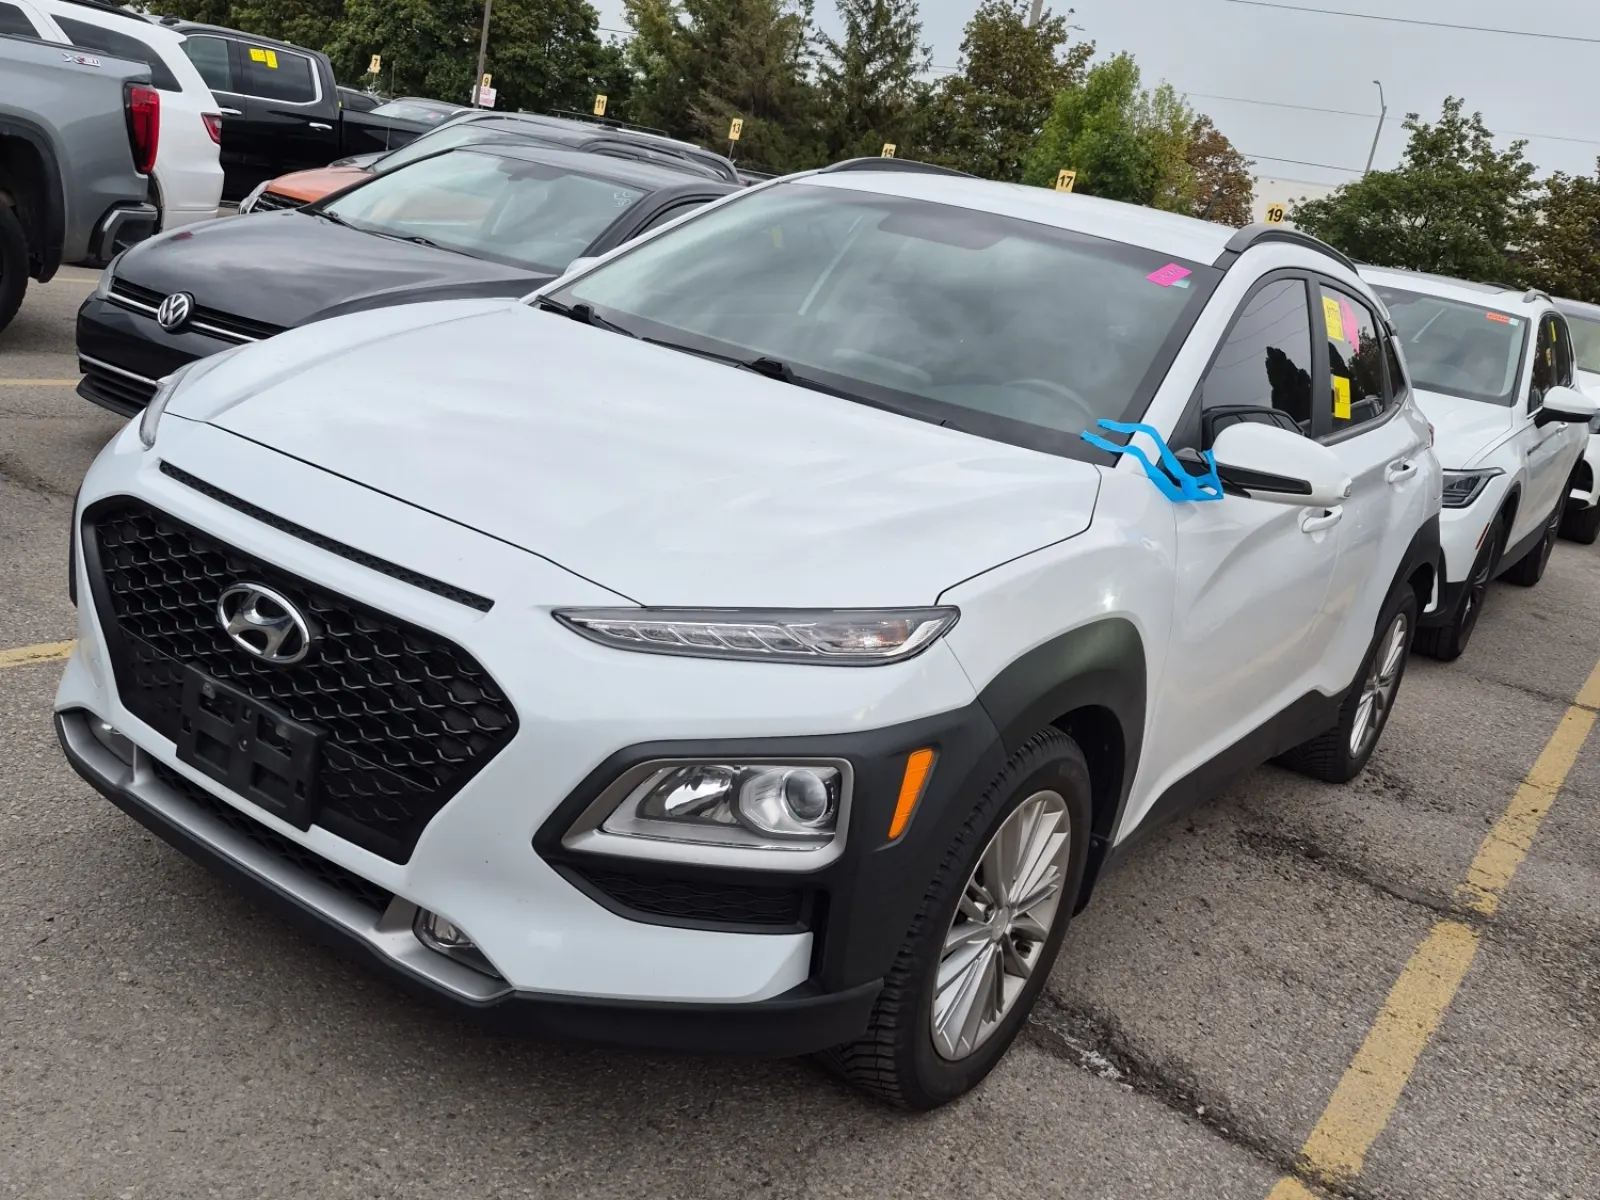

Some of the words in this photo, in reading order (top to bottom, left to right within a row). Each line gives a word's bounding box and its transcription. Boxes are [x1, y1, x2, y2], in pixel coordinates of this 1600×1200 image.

[596, 99, 604, 109] 11
[732, 123, 740, 133] 13
[884, 149, 893, 158] 15
[1059, 175, 1073, 188] 17
[1268, 207, 1283, 222] 19
